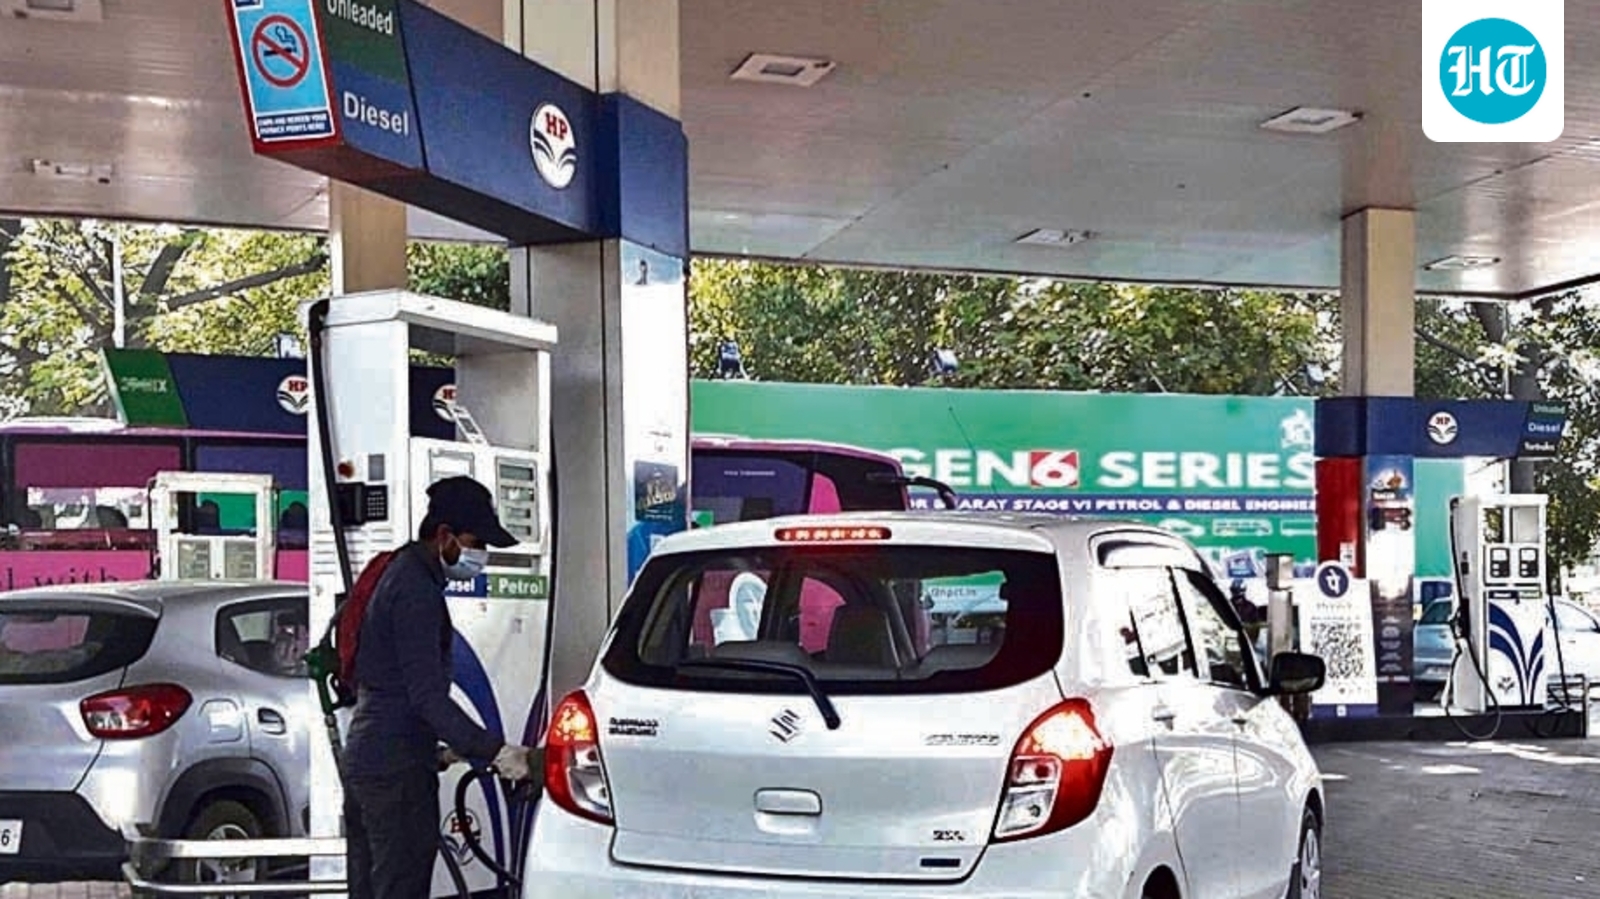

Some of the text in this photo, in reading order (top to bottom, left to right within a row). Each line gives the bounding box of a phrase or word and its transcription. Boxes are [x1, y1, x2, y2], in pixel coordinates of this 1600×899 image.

[327, 0, 394, 35] Unleaded
[343, 91, 409, 136] Diesel
[546, 112, 568, 140] HP
[289, 380, 308, 392] HP
[1528, 422, 1560, 432] Diesel
[1097, 451, 1314, 488] SERIES
[1013, 499, 1068, 510] STAGE
[1073, 500, 1091, 510] VI
[1095, 499, 1161, 510] PETROL
[1166, 499, 1182, 510] &
[1184, 499, 1241, 510] DIESEL
[498, 577, 544, 594] Petrol
